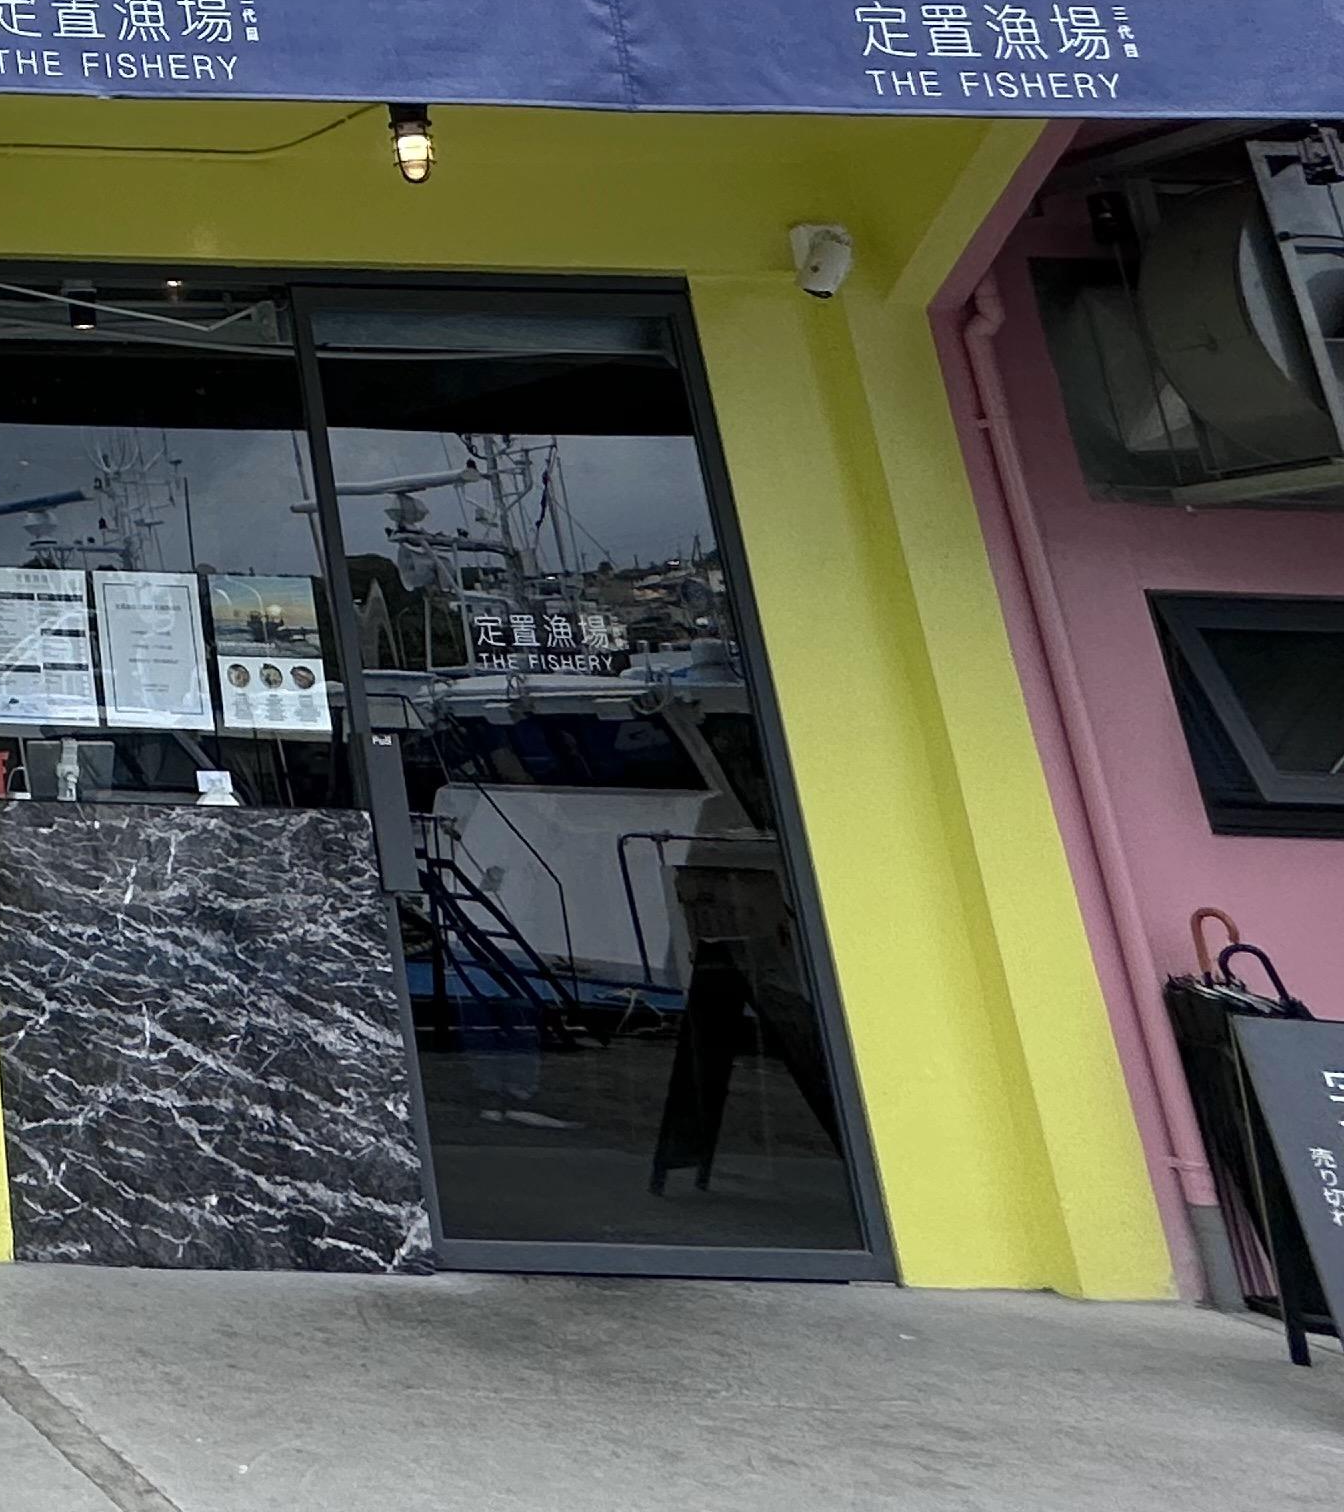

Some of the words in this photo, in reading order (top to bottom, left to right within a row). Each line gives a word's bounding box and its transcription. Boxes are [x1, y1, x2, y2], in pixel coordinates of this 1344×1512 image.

[854, 1, 1110, 60] 定置漁場
[81, 52, 238, 80] FISHERY
[865, 70, 942, 96] THE
[959, 72, 1119, 99] FISHERY
[473, 613, 610, 649] 定置漁場
[478, 652, 521, 670] THE
[528, 653, 614, 672] FISHERY
